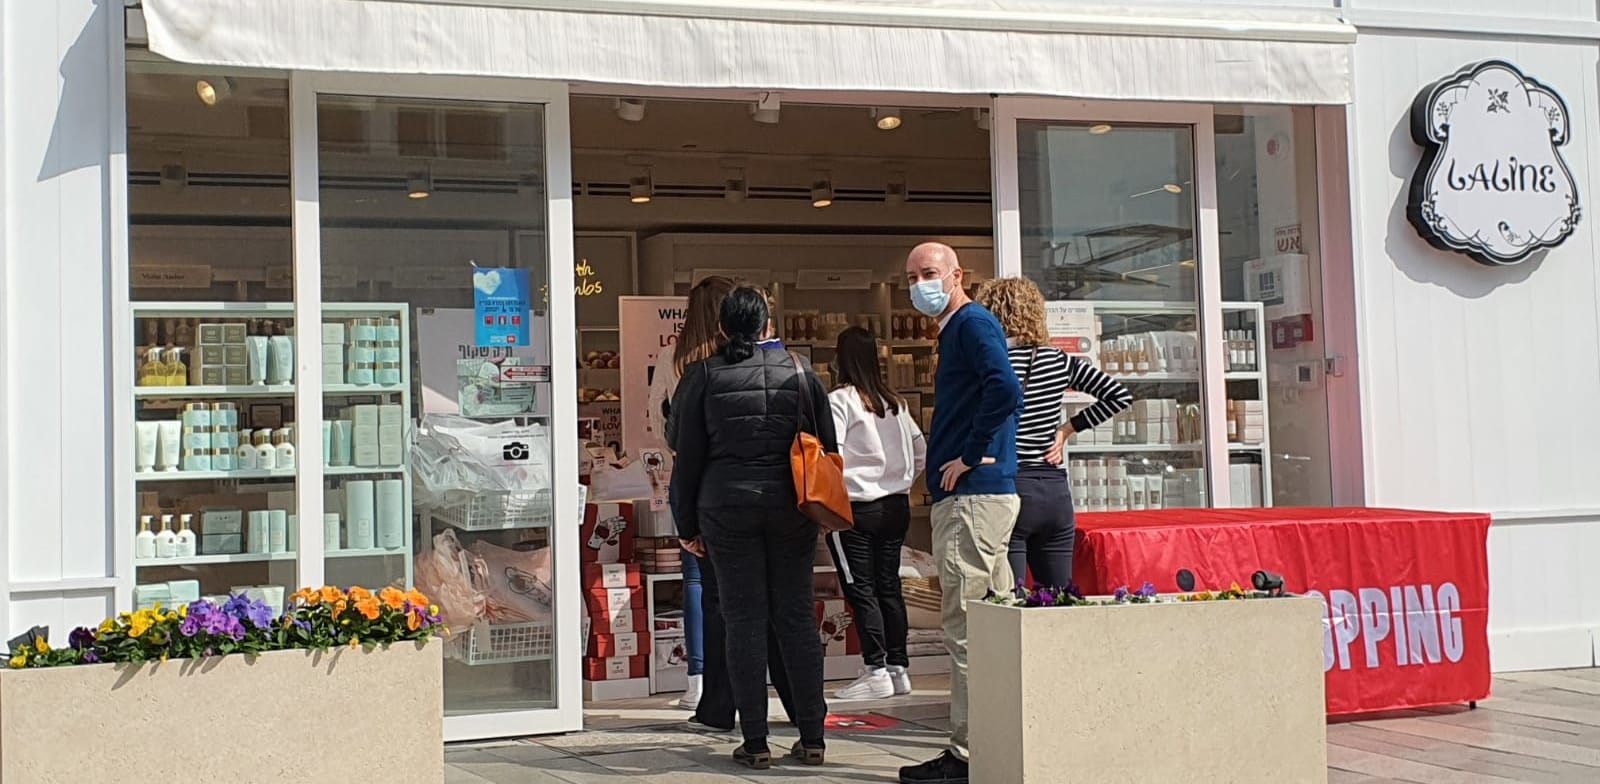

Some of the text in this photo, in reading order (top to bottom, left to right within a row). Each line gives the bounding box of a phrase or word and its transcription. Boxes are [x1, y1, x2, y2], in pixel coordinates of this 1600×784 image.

[1277, 235, 1300, 252] אש
[658, 308, 689, 320] WHA
[659, 334, 678, 347] LO
[602, 407, 621, 415] WHA
[602, 422, 621, 431] LOV
[1305, 582, 1464, 674] OPPING
